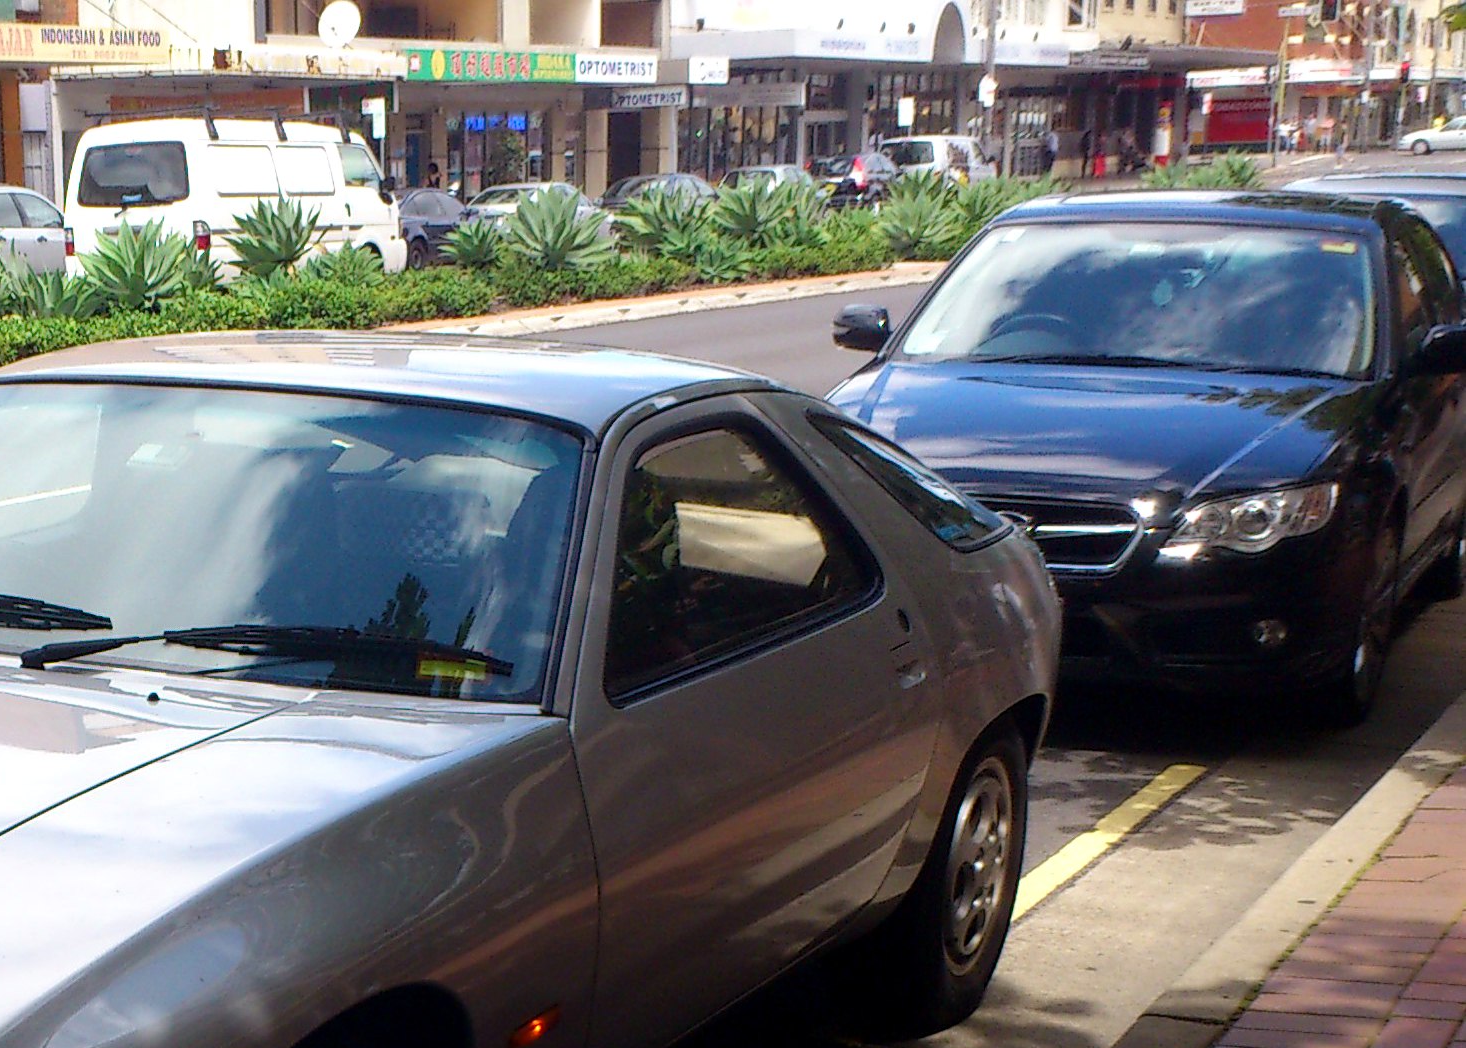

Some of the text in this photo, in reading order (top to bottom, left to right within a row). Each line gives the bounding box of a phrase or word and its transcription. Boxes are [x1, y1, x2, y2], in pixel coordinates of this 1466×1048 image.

[41, 28, 161, 47] INDONESIAN & ASIAN FOOD
[579, 60, 654, 76] OPTOMETRIST
